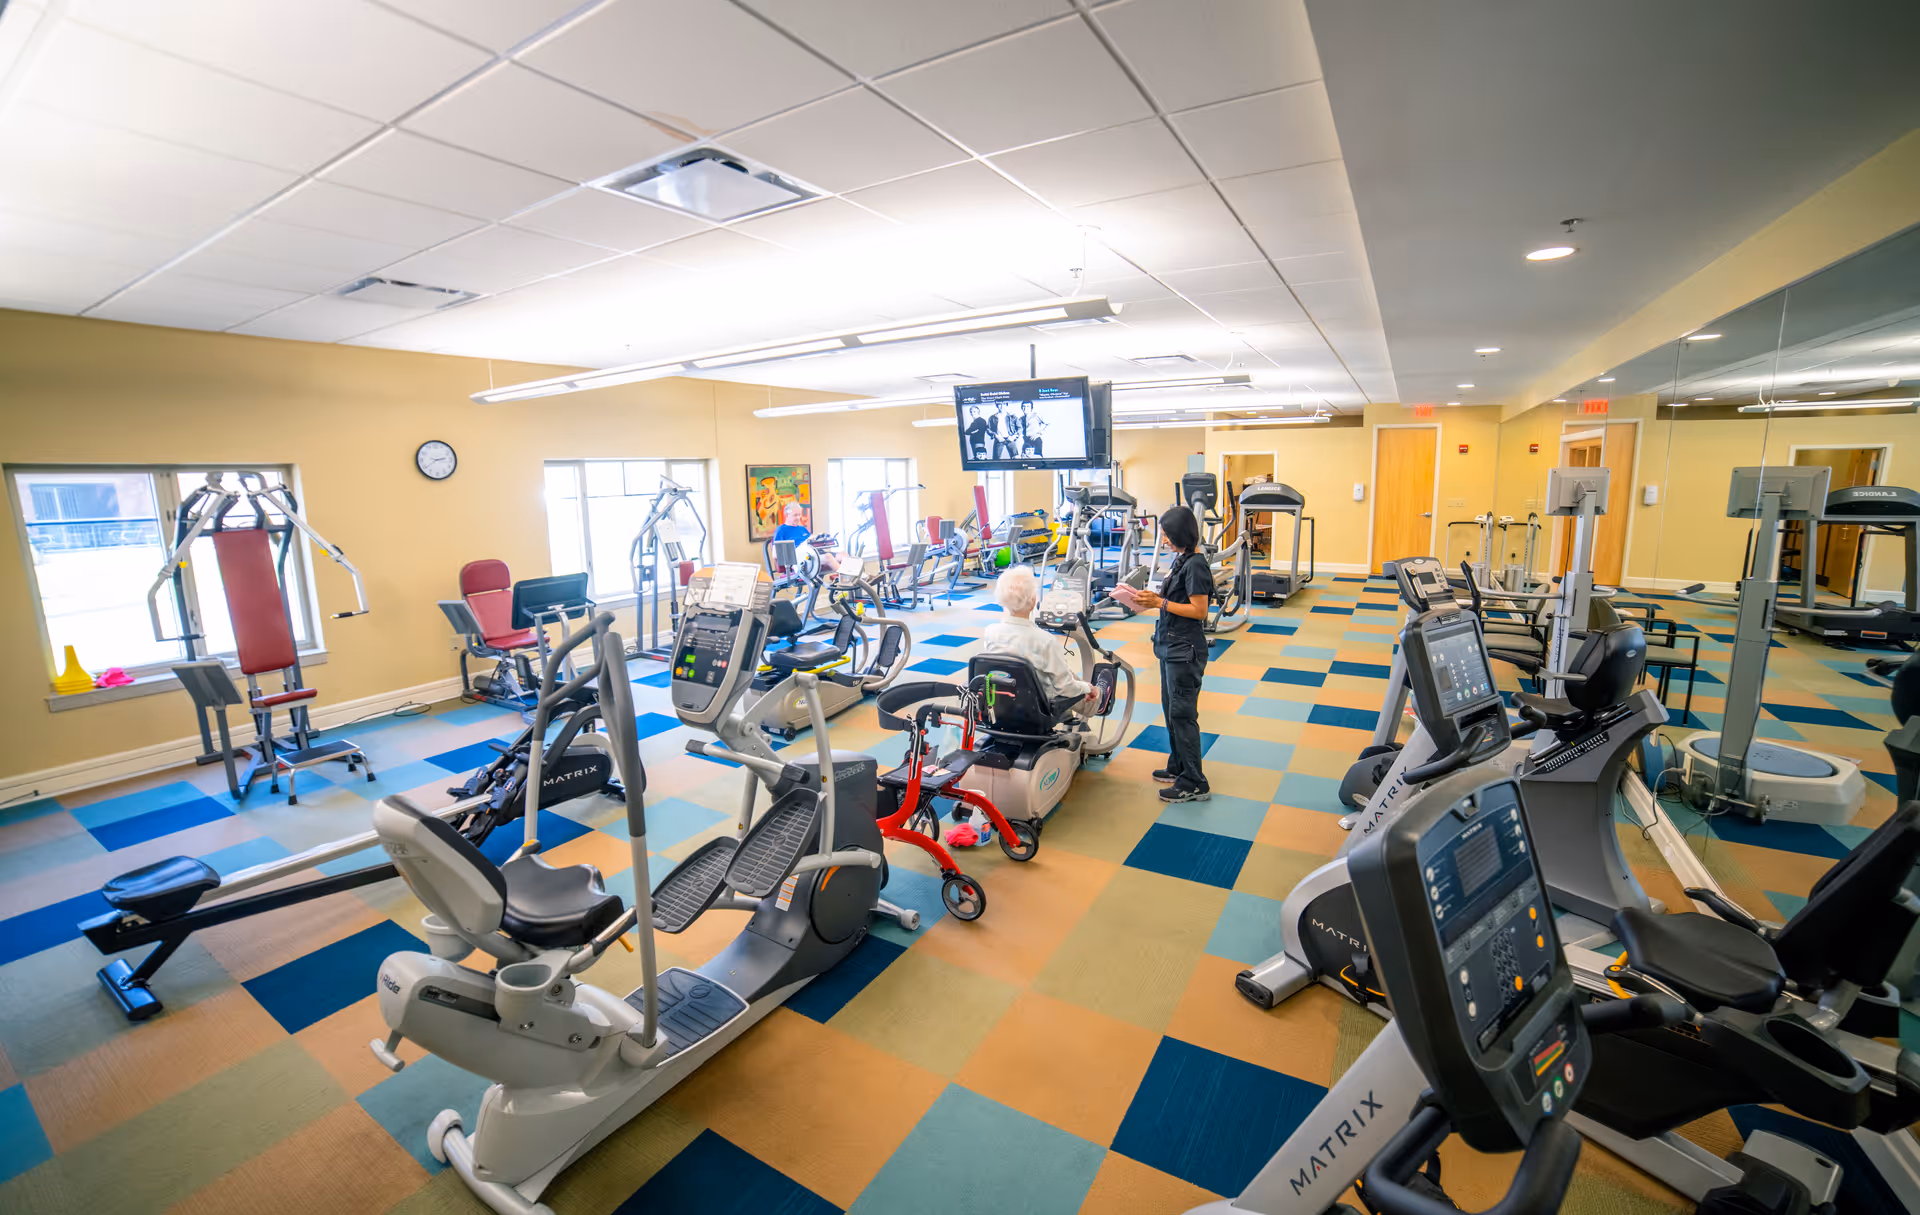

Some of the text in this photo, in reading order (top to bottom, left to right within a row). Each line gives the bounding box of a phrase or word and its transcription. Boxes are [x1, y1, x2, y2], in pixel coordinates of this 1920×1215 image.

[543, 765, 597, 787] MATRIX
[1312, 918, 1367, 952] MATRI
[1289, 1089, 1384, 1196] MATRIX
